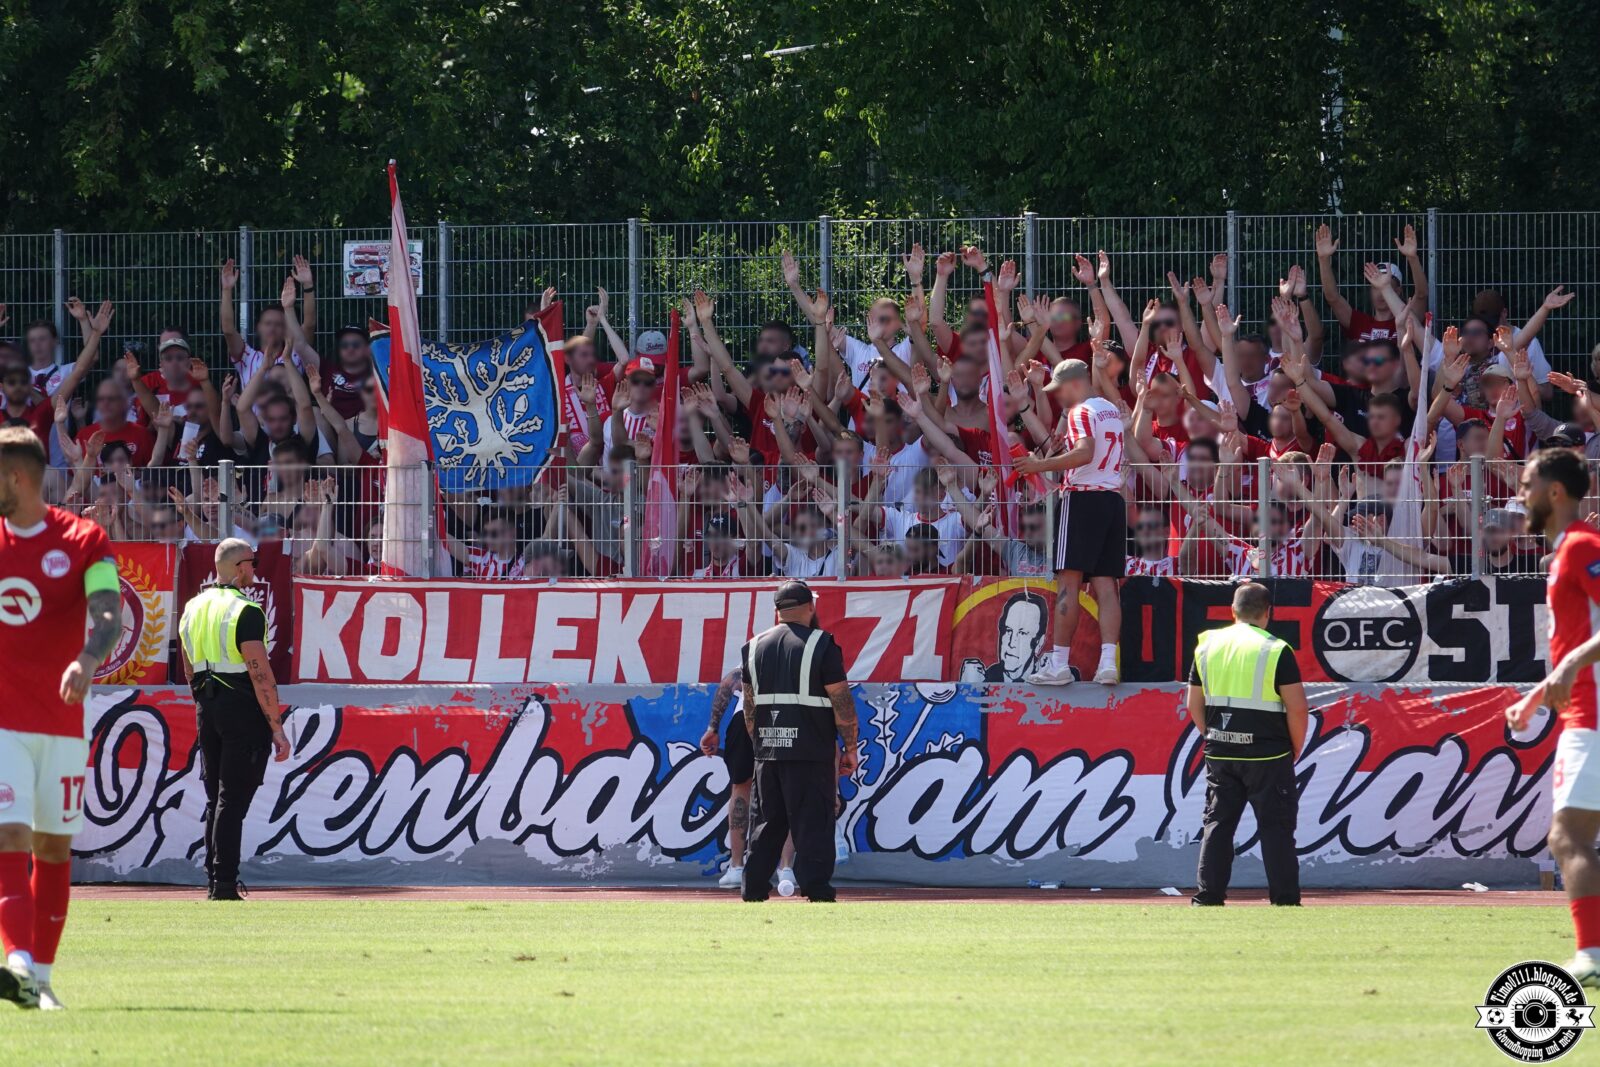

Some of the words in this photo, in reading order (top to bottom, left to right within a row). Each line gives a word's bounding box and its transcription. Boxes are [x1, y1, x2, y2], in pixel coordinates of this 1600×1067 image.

[1098, 431, 1123, 474] 71
[845, 587, 946, 681] 71
[1323, 620, 1414, 648] O.F.C.
[60, 776, 86, 811] 17
[865, 739, 1136, 861] am
